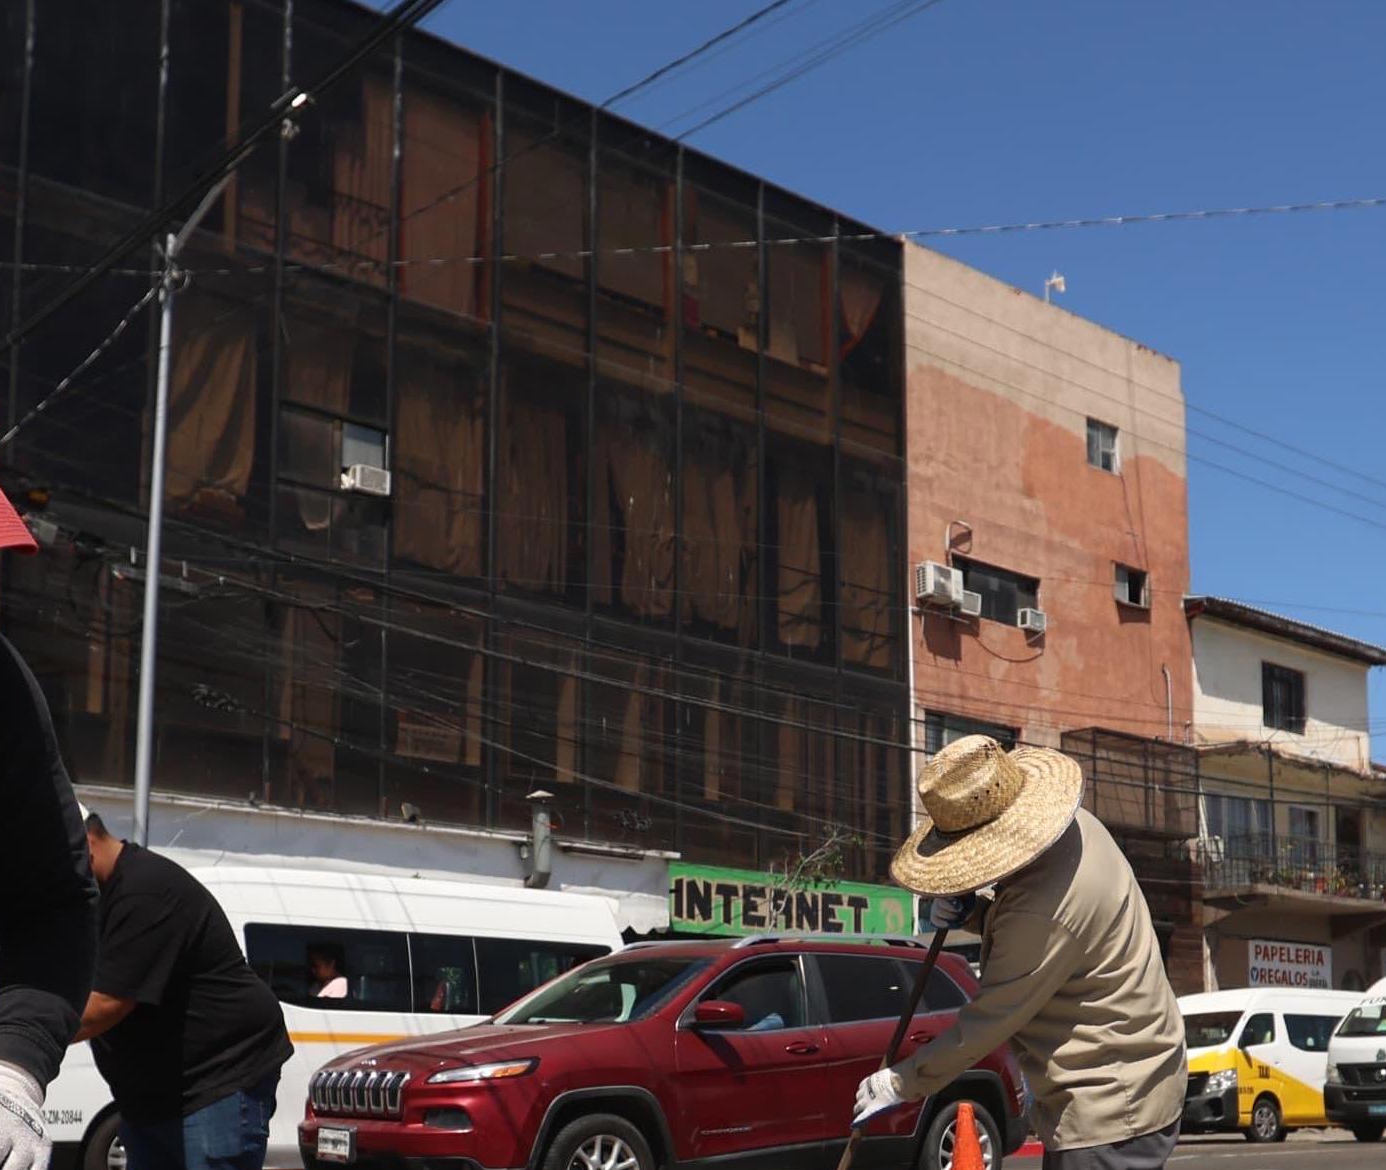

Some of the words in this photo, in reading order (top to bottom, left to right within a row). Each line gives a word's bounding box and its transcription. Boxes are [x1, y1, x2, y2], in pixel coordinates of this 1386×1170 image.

[673, 877, 870, 934] INTERNET
[1254, 944, 1325, 967] PAPELERIA
[1260, 967, 1309, 987] REGALOS
